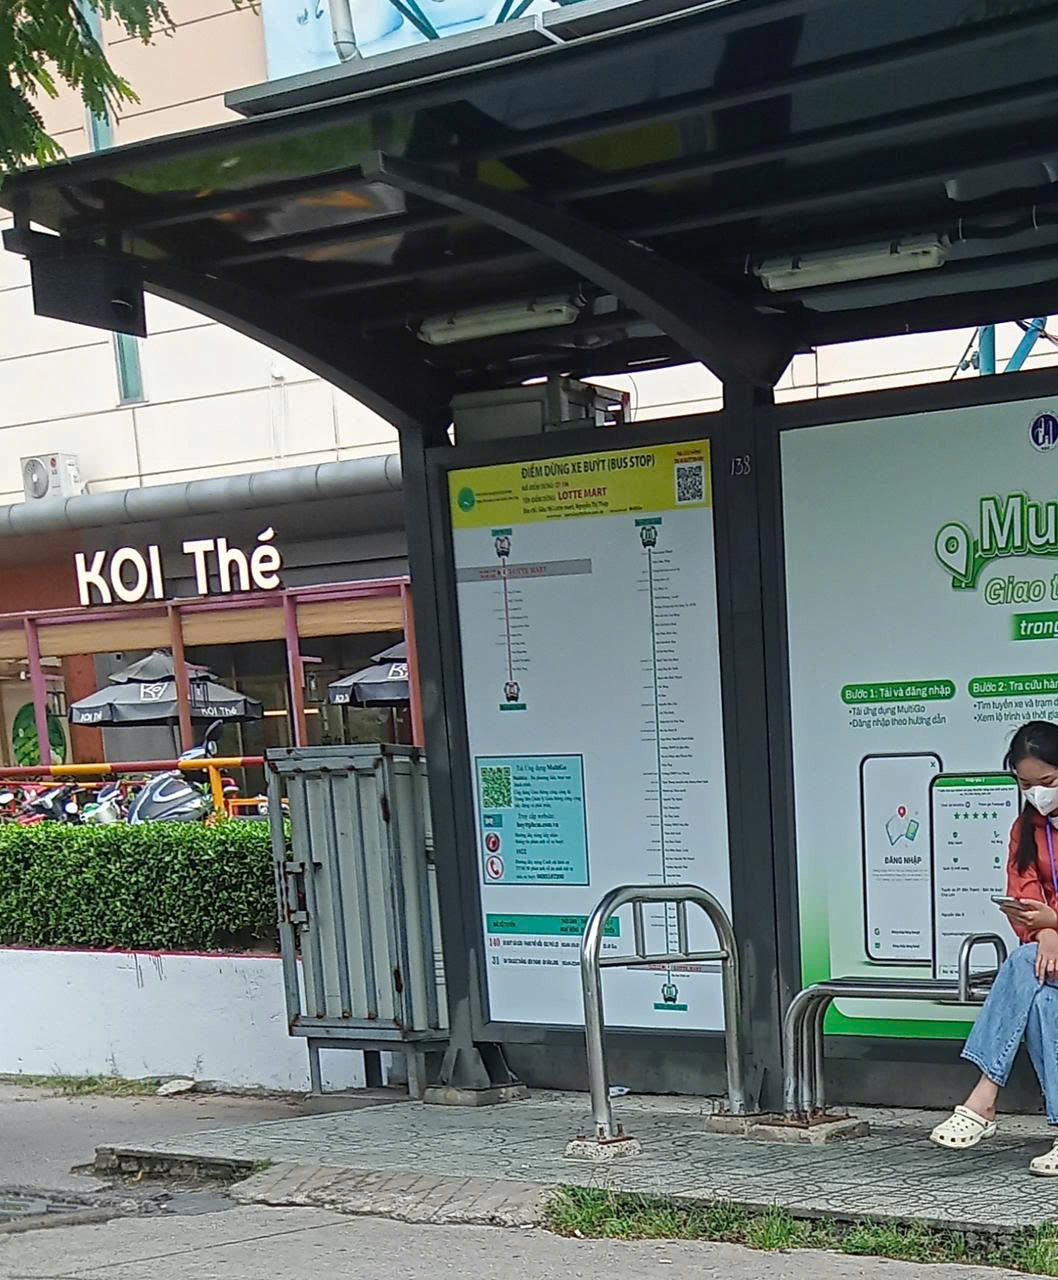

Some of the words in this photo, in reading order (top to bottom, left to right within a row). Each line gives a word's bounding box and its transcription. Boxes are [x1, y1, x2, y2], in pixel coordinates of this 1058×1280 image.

[521, 463, 543, 479] ĐIỂM
[544, 461, 570, 477] DỪNG
[571, 462, 583, 474] XE
[584, 457, 606, 473] BUÝT
[608, 457, 628, 471] (BUS
[629, 454, 656, 468] STOP)
[731, 455, 751, 476] 138
[557, 488, 583, 501] LOTTE
[583, 487, 607, 498] MART
[74, 545, 166, 606] KOI
[182, 526, 282, 596] Thé
[985, 576, 1046, 605] Giao
[845, 688, 868, 699] Bước
[870, 689, 878, 698] 1:
[879, 687, 892, 697] Tải
[893, 687, 904, 697] và
[905, 685, 928, 698] đăng
[928, 684, 951, 697] nhập
[973, 682, 997, 693] Bước
[998, 682, 1007, 692] 2:
[1009, 681, 1024, 691] Tra
[1025, 678, 1042, 690] cứu
[897, 704, 926, 713] MultiGo
[1025, 698, 1034, 708] và
[1035, 698, 1053, 709] trạm
